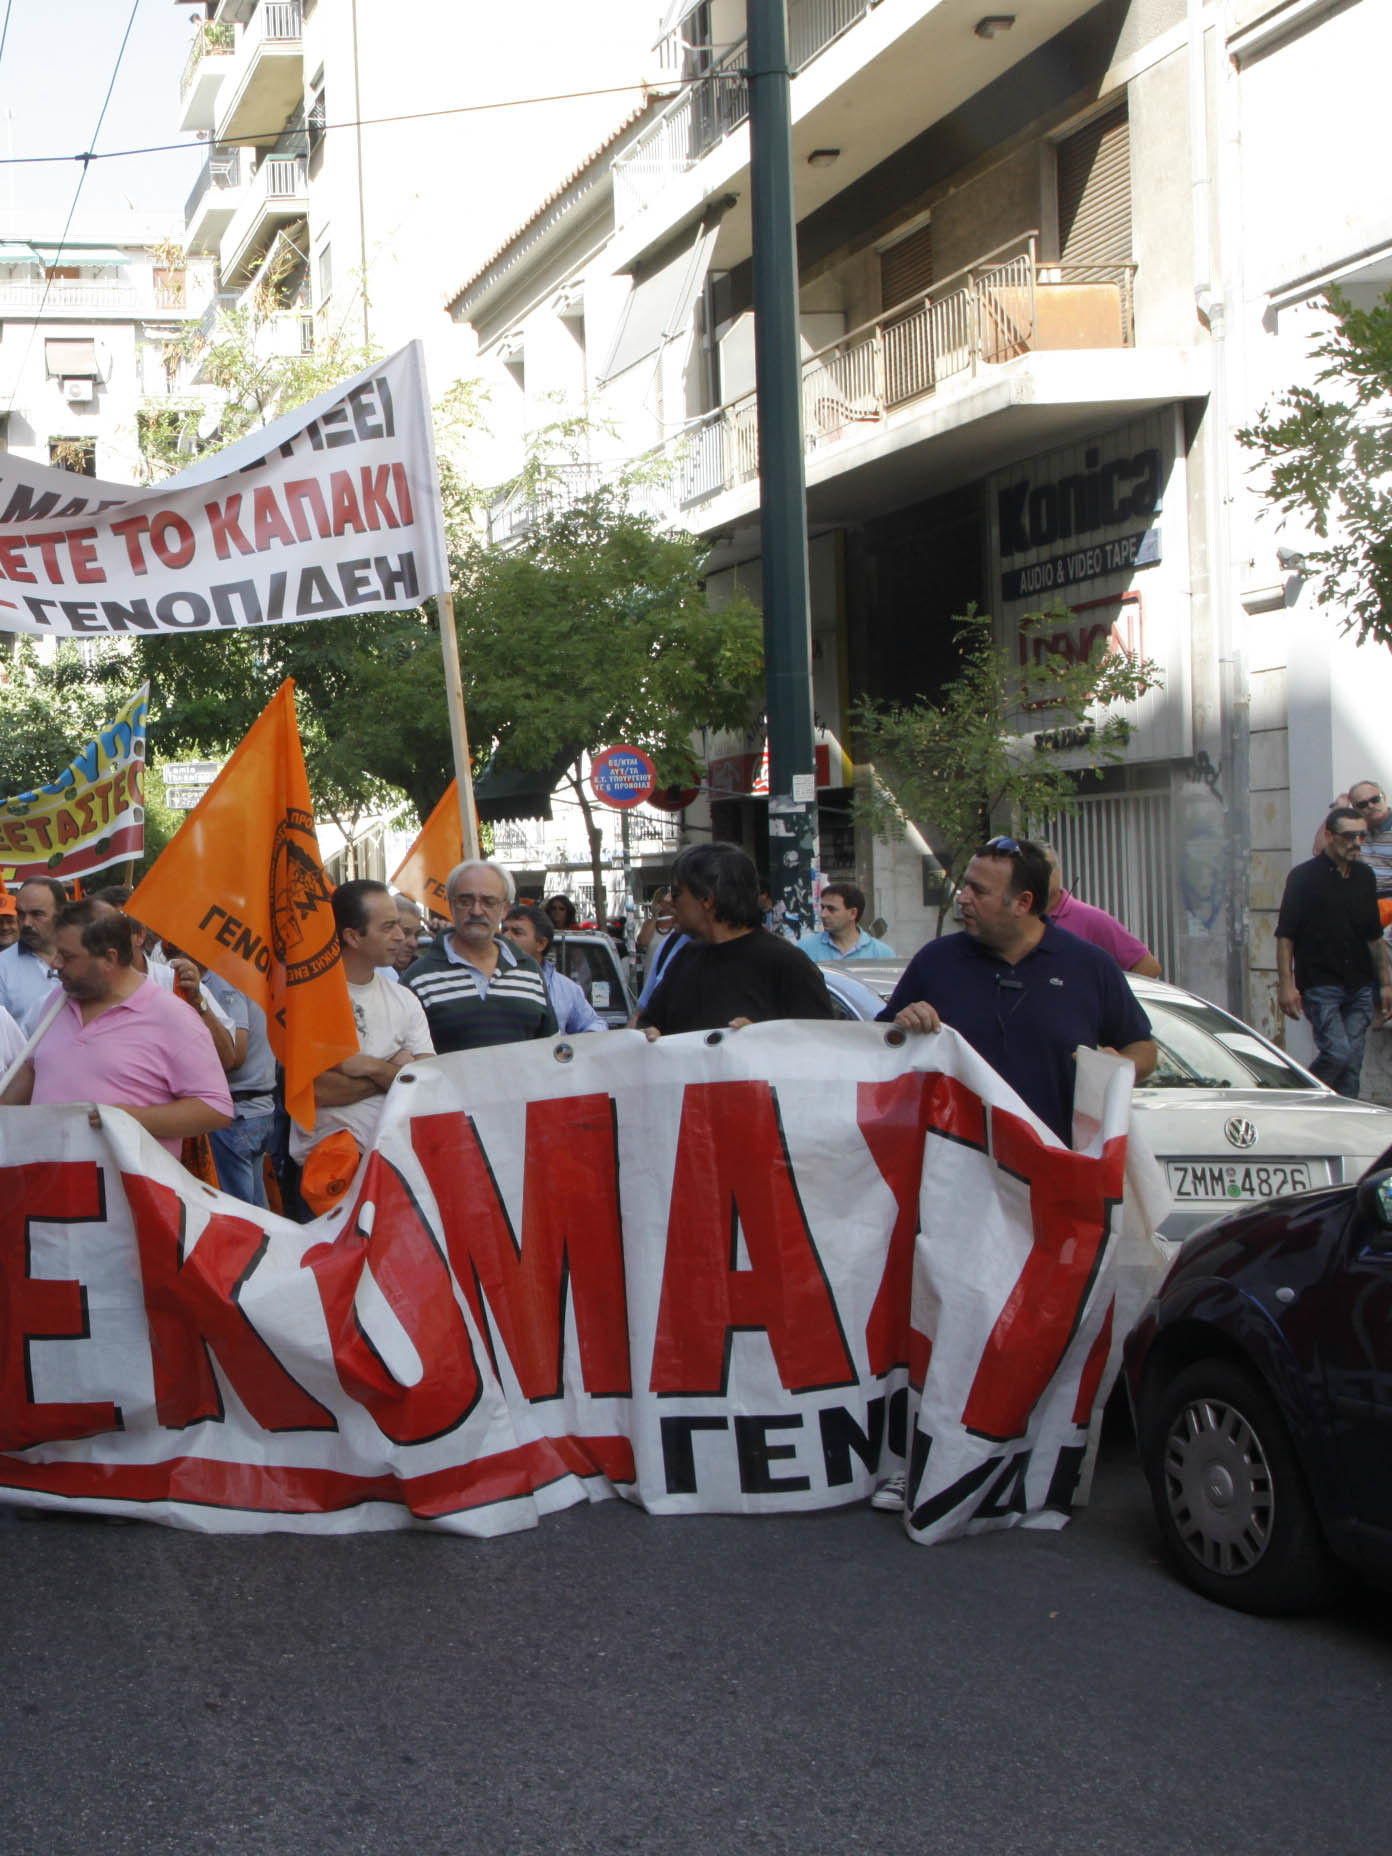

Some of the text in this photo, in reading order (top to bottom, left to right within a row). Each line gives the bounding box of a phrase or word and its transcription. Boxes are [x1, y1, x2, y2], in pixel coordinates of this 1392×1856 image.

[0, 485, 126, 526] ΜΑ
[111, 510, 196, 577] ΤΟ
[206, 461, 414, 561] ΚΑΠΑΚΙ
[998, 448, 1163, 557] Konica
[22, 551, 420, 632] ΓΕΝΟΠ/ΔΕΗ
[1019, 537, 1138, 594] AUDIO & VIDEO TAPE
